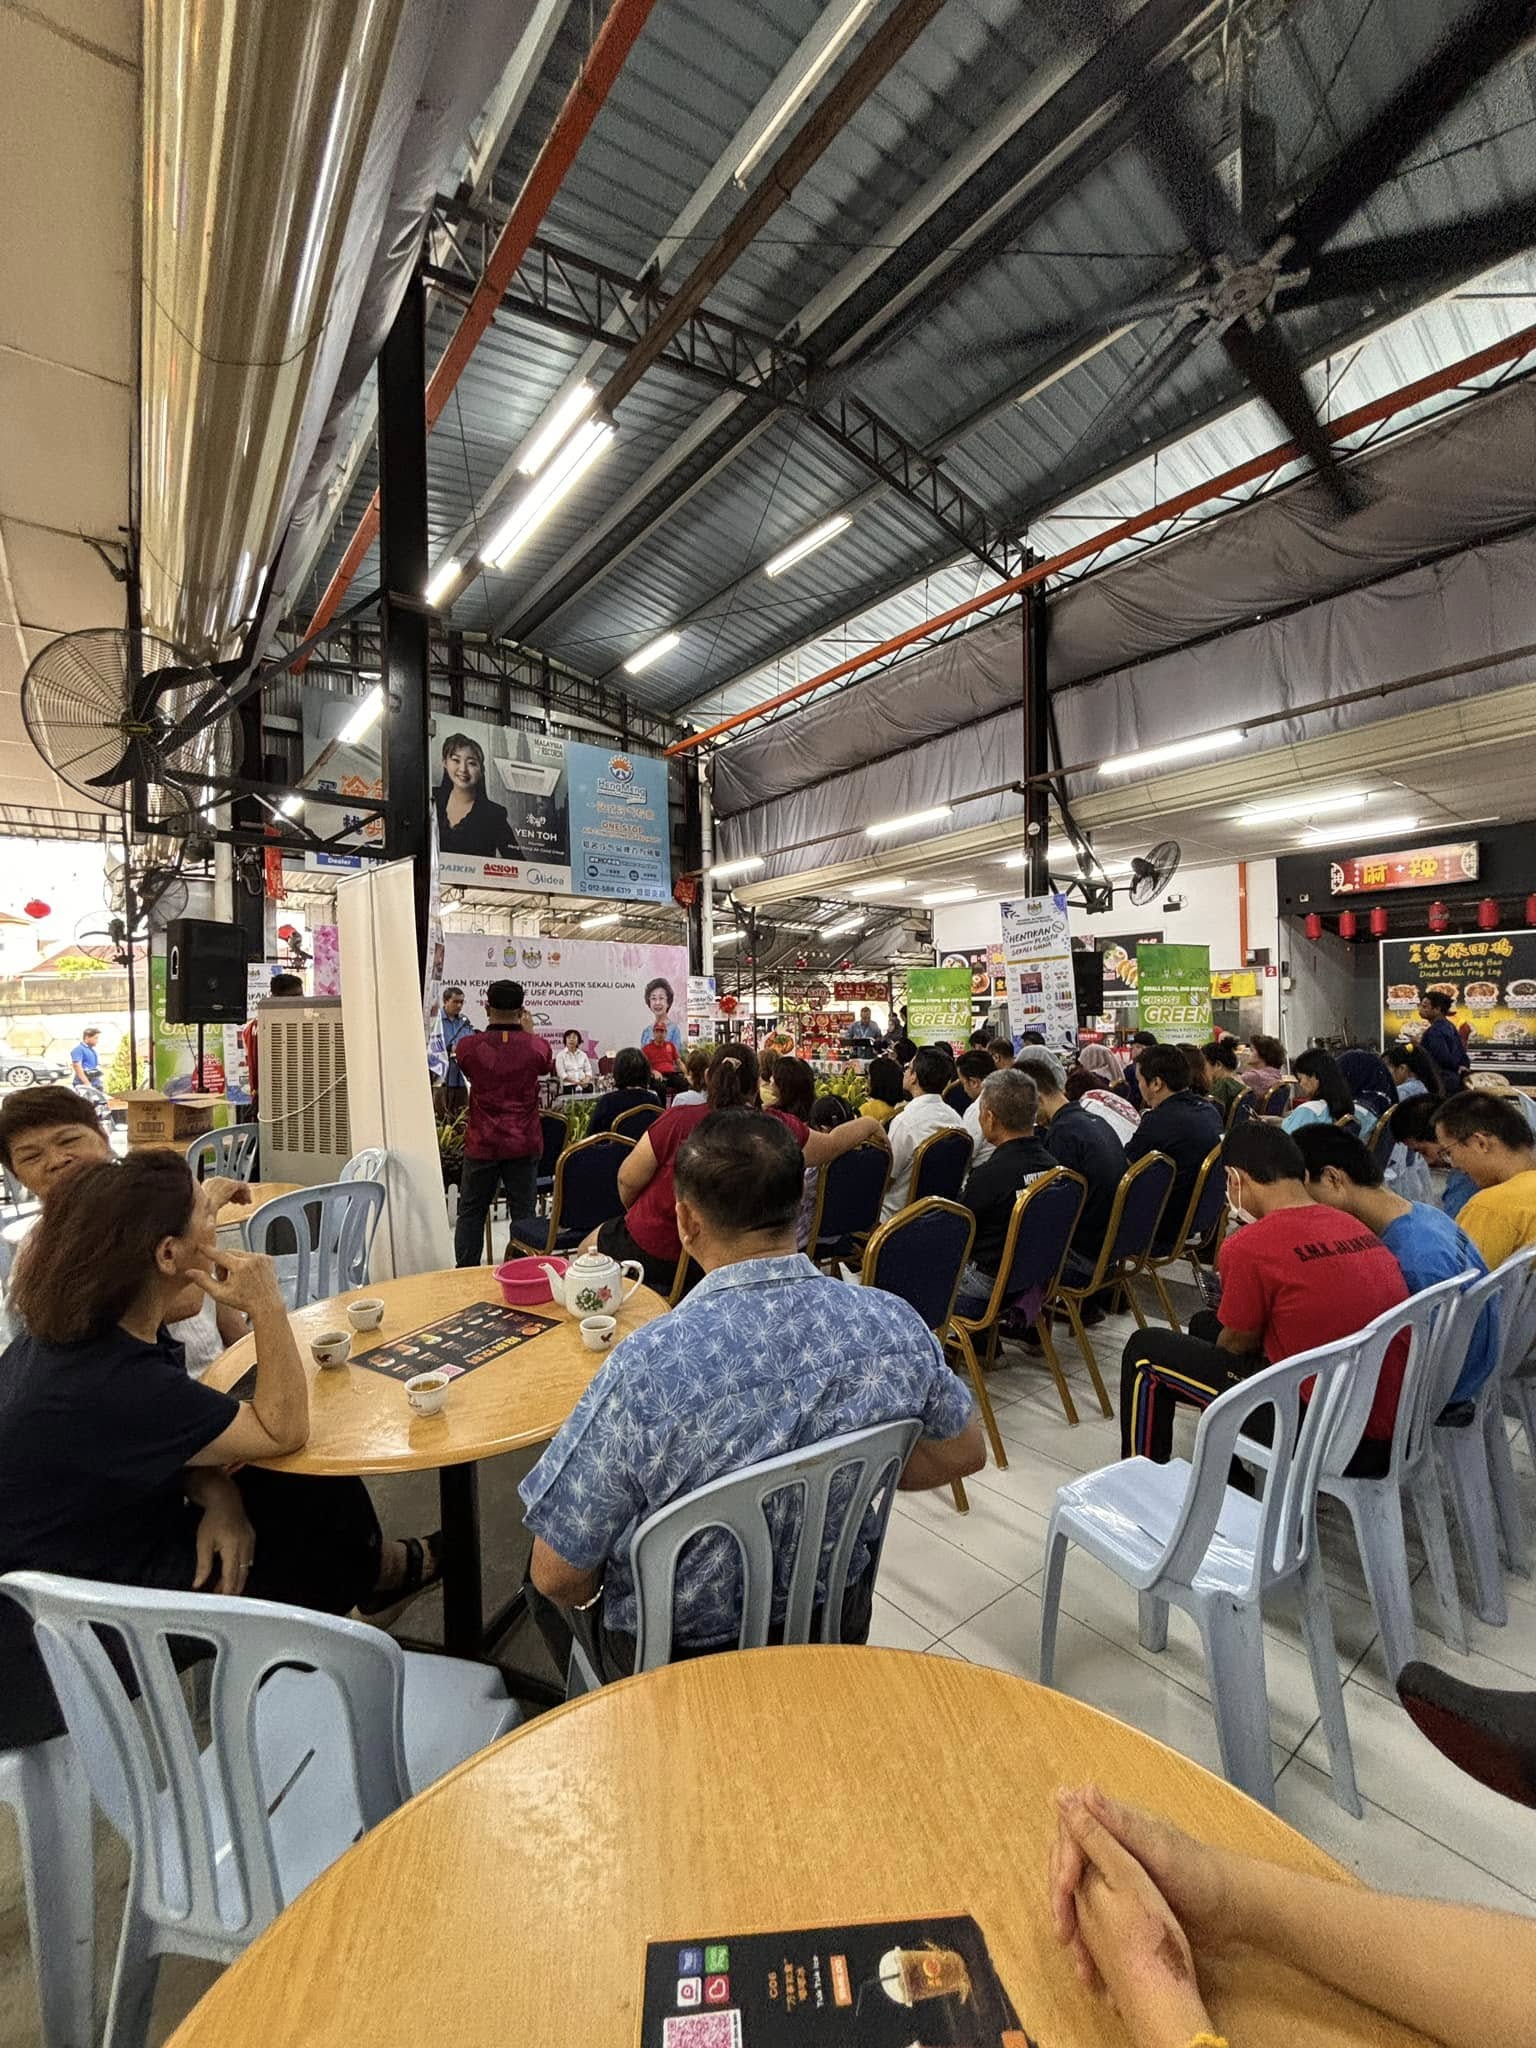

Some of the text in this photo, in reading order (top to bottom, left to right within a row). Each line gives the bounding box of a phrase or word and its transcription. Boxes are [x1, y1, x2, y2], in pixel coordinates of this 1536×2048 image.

[514, 827, 557, 841] YEN TOH
[327, 857, 352, 866] Dealer
[1009, 925, 1051, 943] HENTIKAN
[530, 988, 547, 996] USE
[554, 981, 586, 989] PLASTIK
[910, 1012, 969, 1026] GREEN
[1144, 1005, 1210, 1025] GREEN
[768, 1971, 778, 1999] C06
